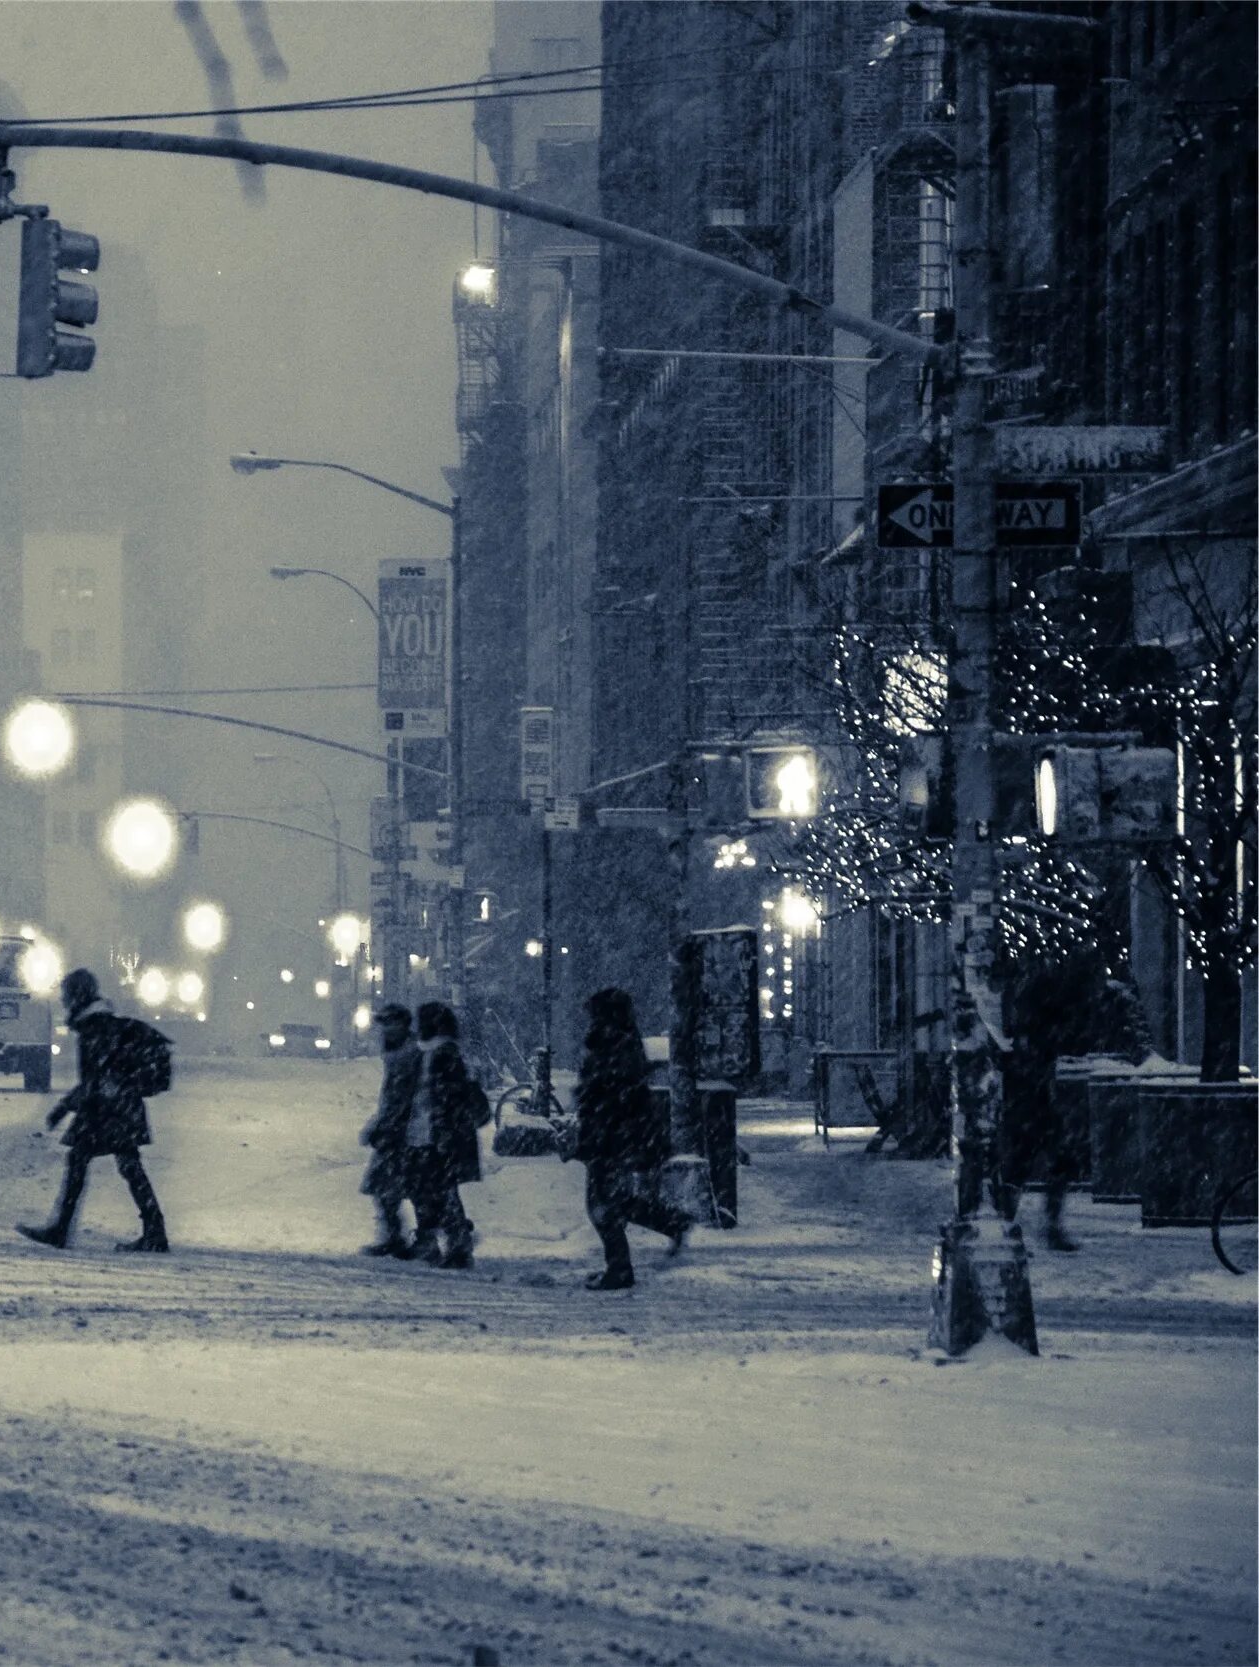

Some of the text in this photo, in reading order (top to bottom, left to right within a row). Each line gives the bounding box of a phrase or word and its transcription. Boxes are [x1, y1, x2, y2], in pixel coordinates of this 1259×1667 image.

[1011, 432, 1121, 469] SPRING
[997, 501, 1054, 528] WAY
[399, 566, 426, 576] NYC
[382, 595, 418, 613] HOW
[382, 613, 444, 656] YOU
[381, 658, 443, 674] BECOME
